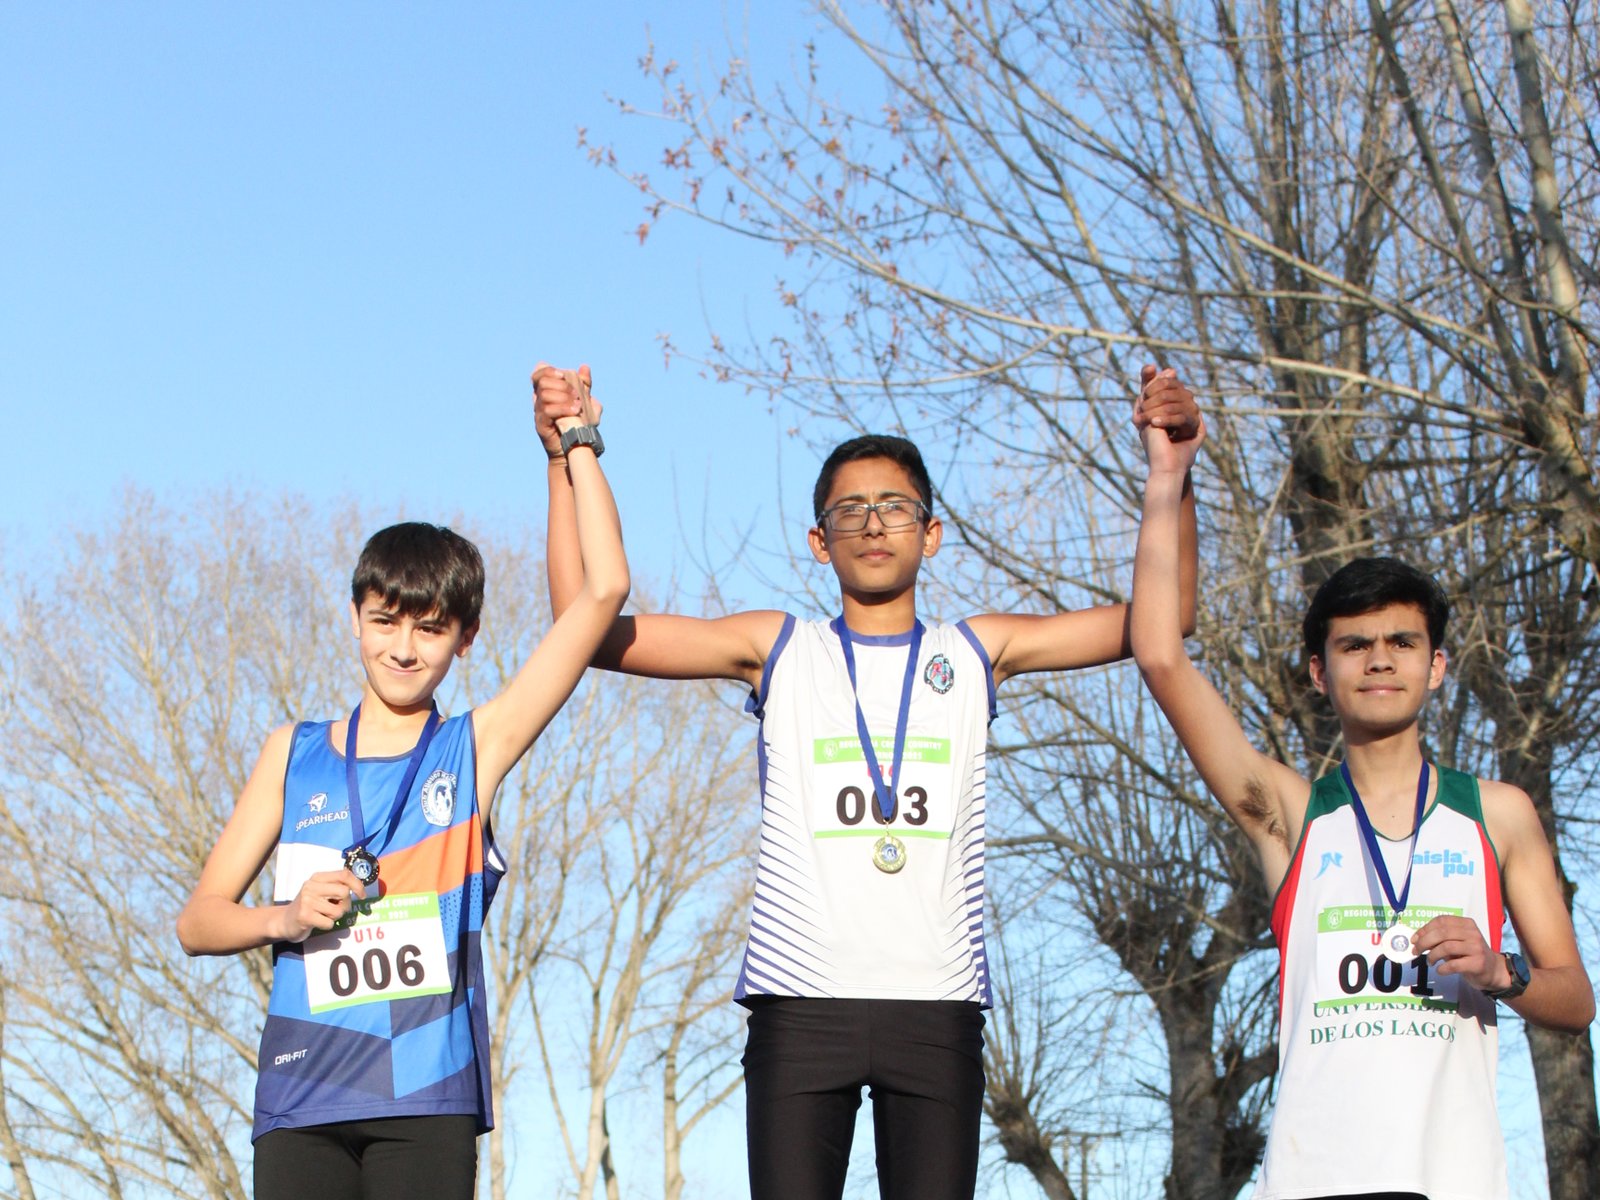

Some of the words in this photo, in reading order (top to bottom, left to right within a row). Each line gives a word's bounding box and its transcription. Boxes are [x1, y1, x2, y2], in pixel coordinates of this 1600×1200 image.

[836, 786, 929, 826] 003
[1412, 849, 1463, 865] aisla
[1443, 860, 1475, 878] pol
[1343, 909, 1385, 918] REGIONAL
[1409, 920, 1430, 929] 202
[353, 925, 386, 944] U16
[329, 944, 426, 997] 006
[1338, 952, 1434, 997] 001
[1310, 1026, 1338, 1045] DE
[1340, 1020, 1385, 1040] LOS
[1391, 1019, 1457, 1044] LAGOS
